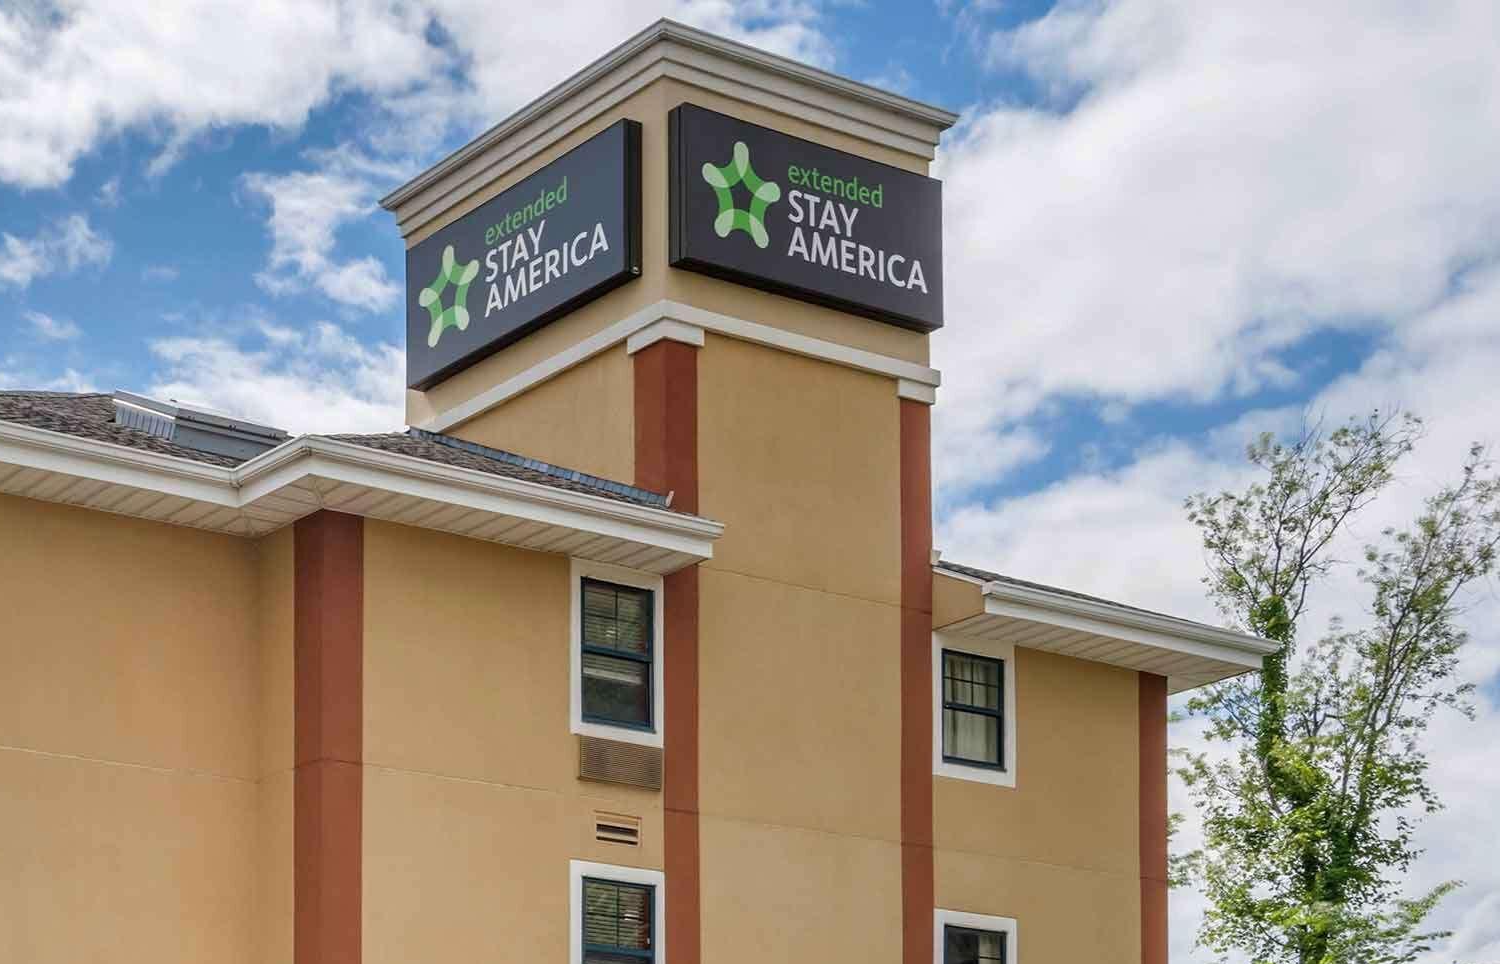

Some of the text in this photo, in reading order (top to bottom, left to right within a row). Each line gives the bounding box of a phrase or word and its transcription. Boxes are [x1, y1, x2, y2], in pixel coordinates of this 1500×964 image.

[485, 176, 568, 245] extended
[788, 165, 883, 208] extended
[788, 190, 859, 237] STAY
[484, 222, 609, 318] AMERICA
[485, 219, 546, 282] STAY
[787, 226, 928, 294] AMERICA
